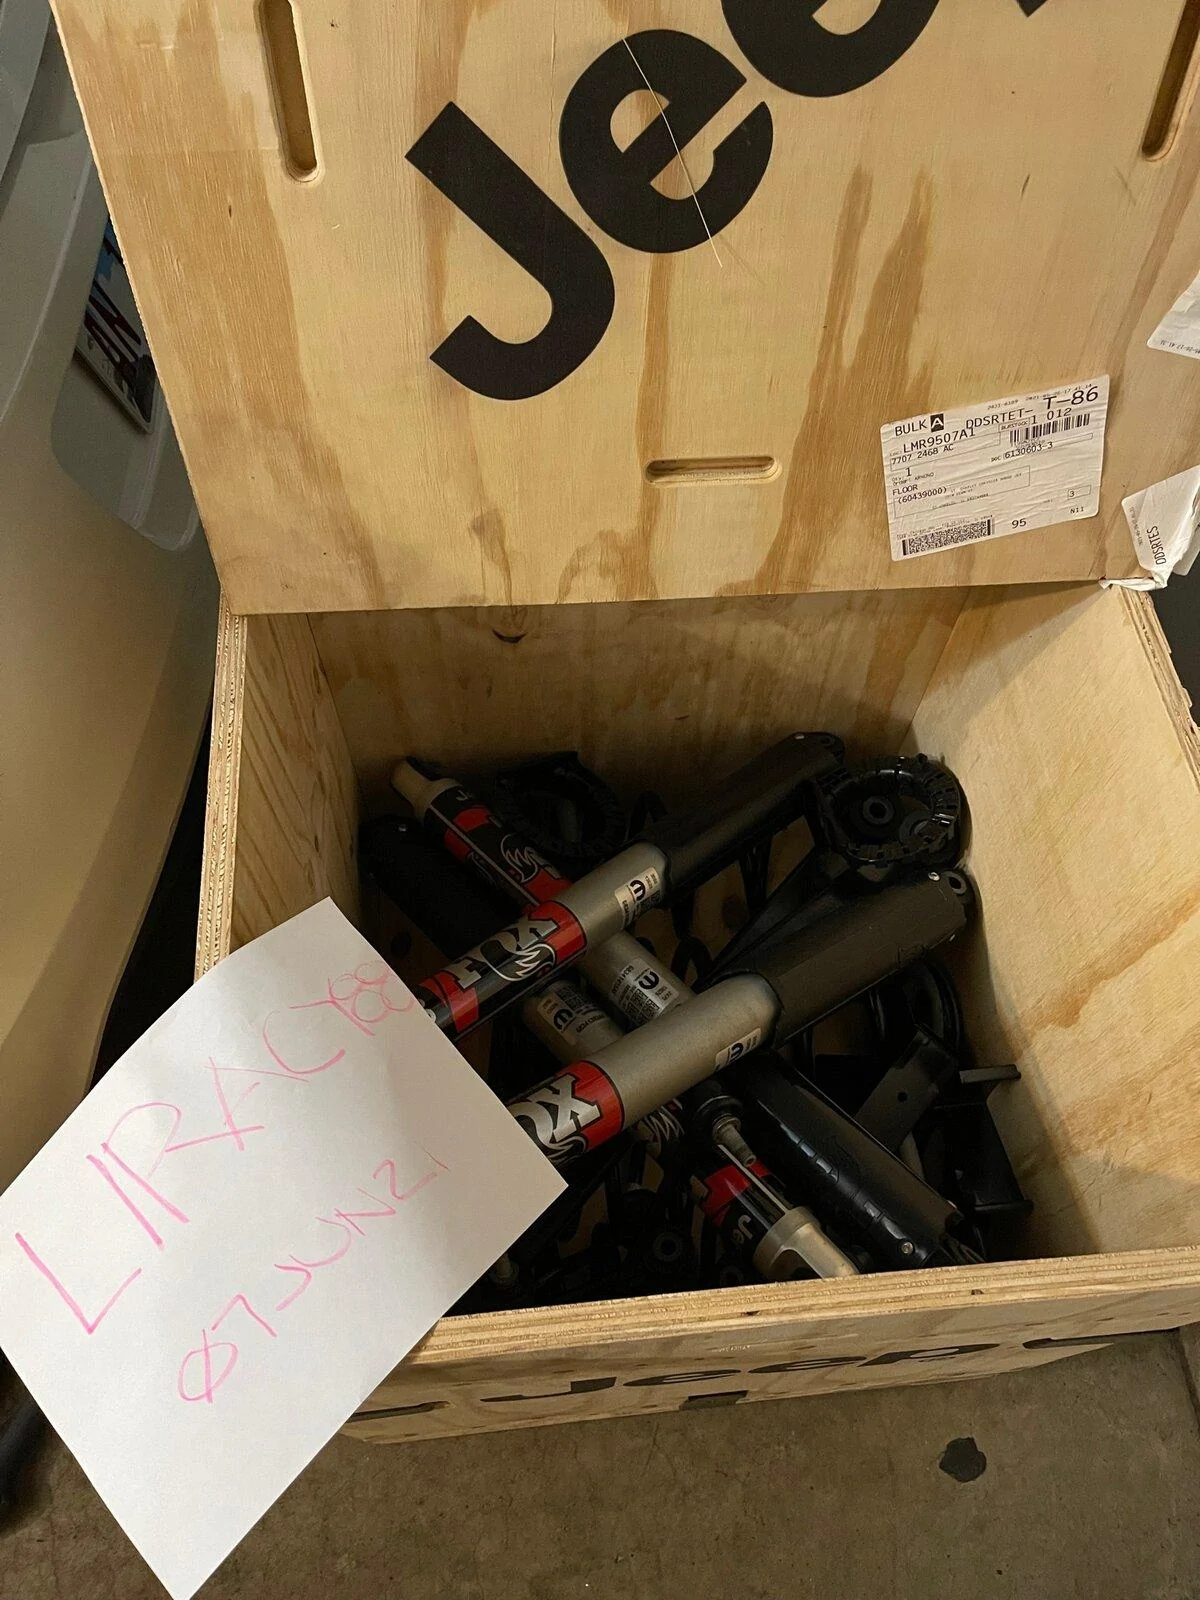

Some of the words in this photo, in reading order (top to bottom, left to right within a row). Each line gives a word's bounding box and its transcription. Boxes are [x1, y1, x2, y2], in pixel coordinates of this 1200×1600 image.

[405, 0, 1050, 400] Je
[1043, 385, 1098, 410] T-86
[1047, 407, 1072, 420] 012
[895, 419, 927, 436] BULK
[903, 427, 976, 453] LMR9507A1
[891, 454, 912, 465] 7707
[917, 447, 939, 459] 2468
[943, 444, 954, 452] AC
[892, 484, 918, 496] FLOOR
[1011, 518, 1027, 529] 95
